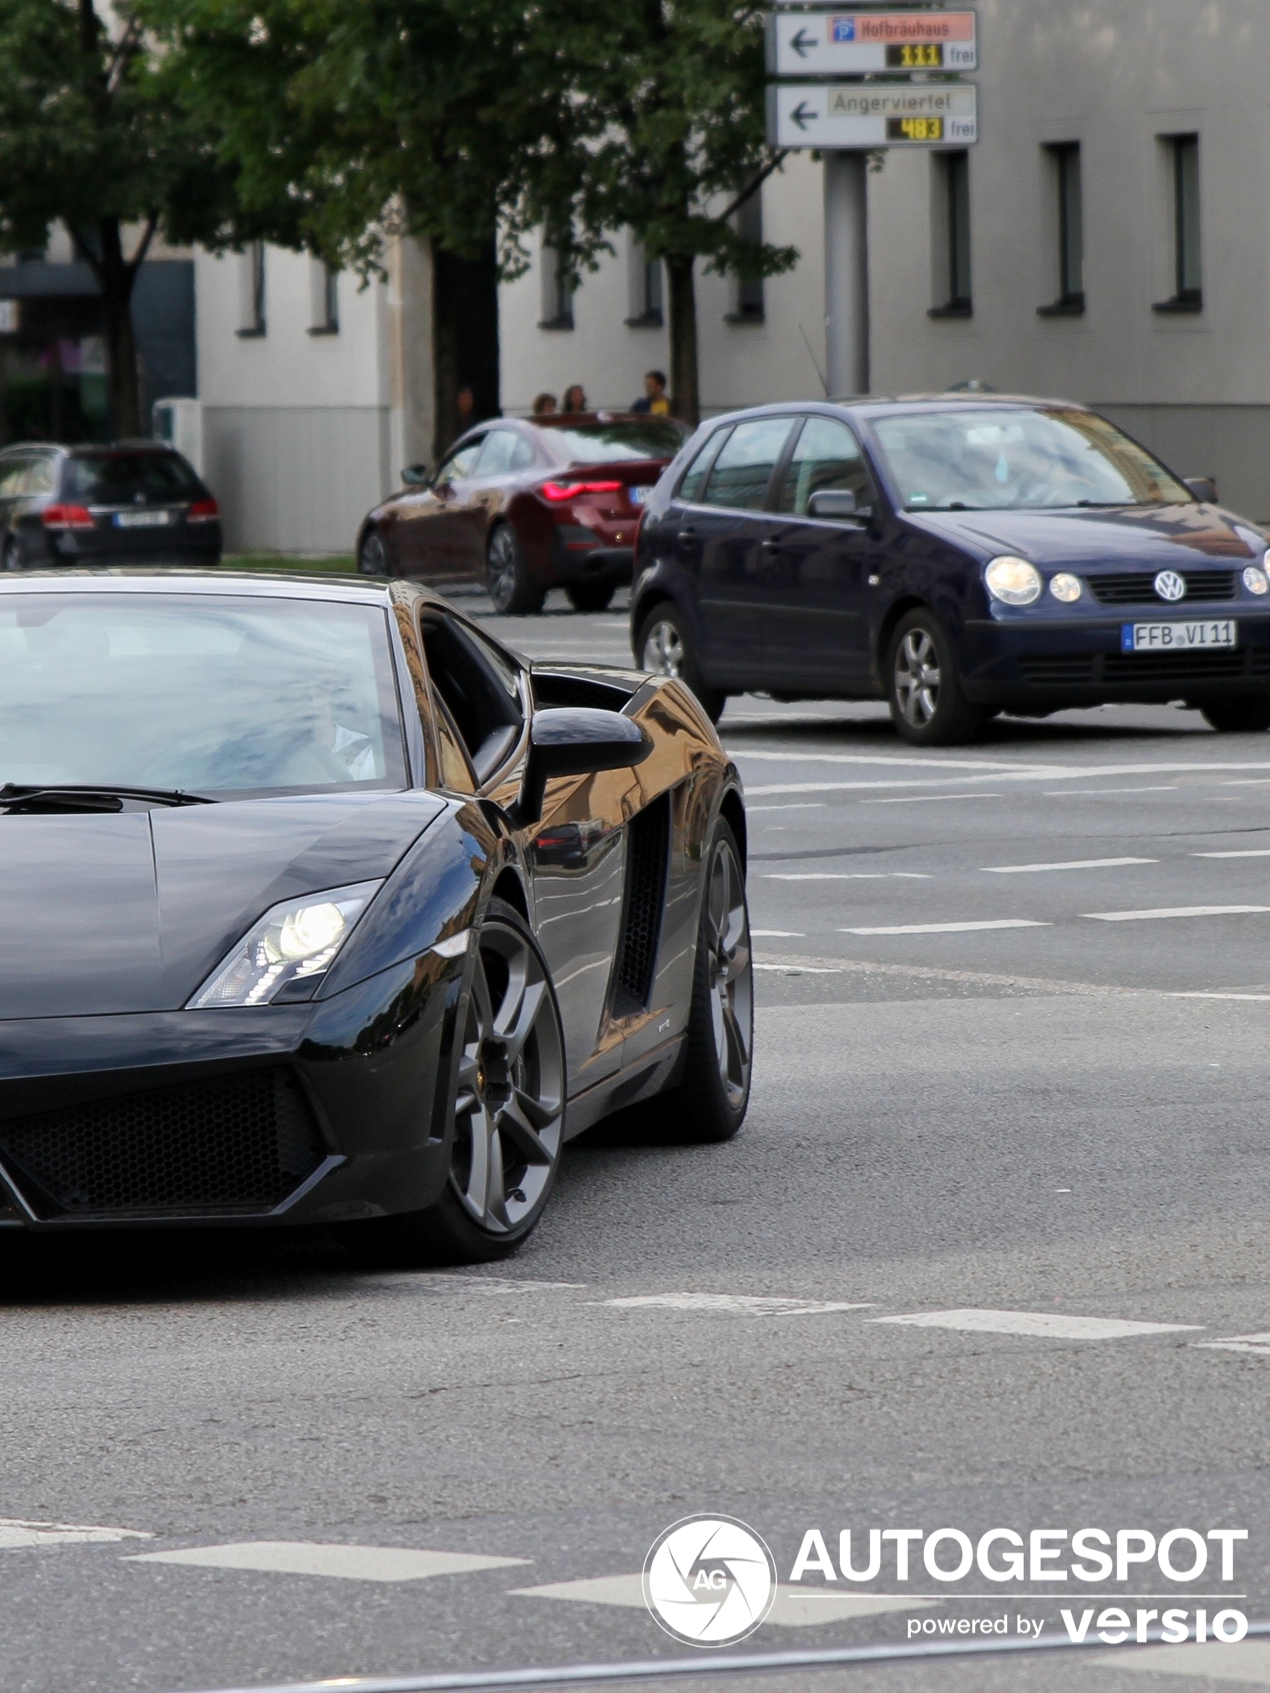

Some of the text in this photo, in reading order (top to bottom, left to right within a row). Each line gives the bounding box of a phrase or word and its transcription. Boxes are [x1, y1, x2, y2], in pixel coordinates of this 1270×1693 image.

[861, 20, 949, 38] Hofbräuhaus
[901, 45, 974, 66] 111 frei
[833, 93, 951, 115] Angerviertel
[901, 117, 974, 139] 483 frei
[1135, 625, 1173, 646] FFB
[1186, 624, 1206, 644] VI
[1210, 622, 1232, 643] 11
